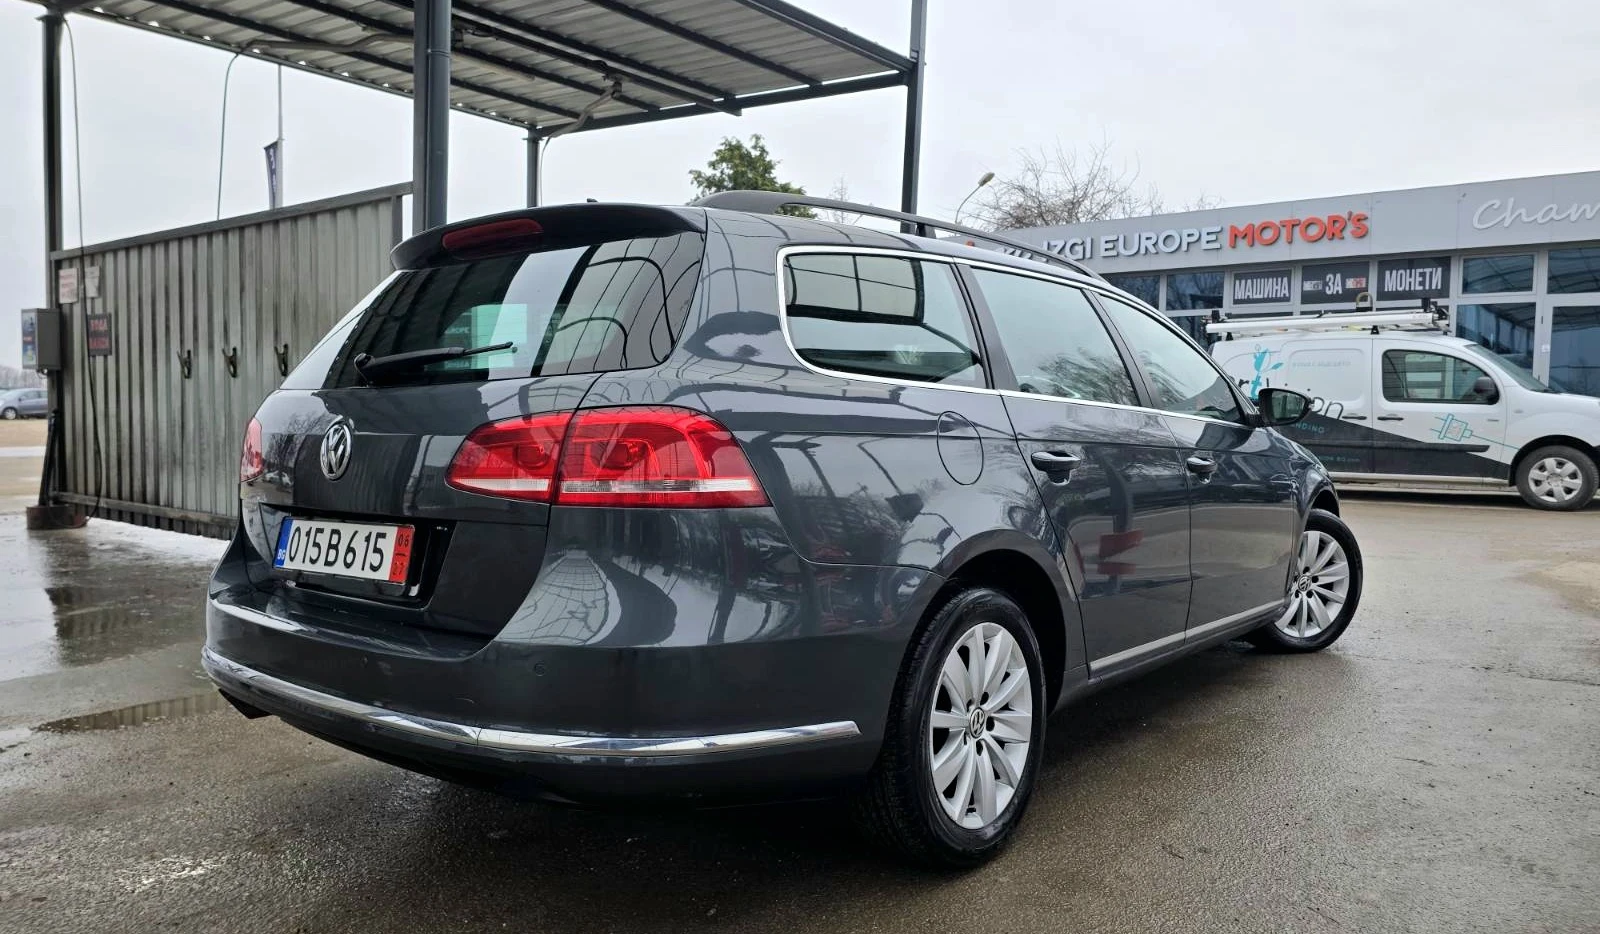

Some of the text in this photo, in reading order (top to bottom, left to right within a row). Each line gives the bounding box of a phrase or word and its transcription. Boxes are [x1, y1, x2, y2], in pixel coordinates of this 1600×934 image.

[1100, 225, 1222, 258] EUROPE
[1229, 211, 1369, 249] MOTOR'S
[1234, 276, 1290, 300] МАШИНА
[1325, 273, 1343, 295] ЗА
[1384, 267, 1442, 292] МОНЕТИ
[277, 548, 286, 560] BG
[288, 526, 387, 573] 015B615
